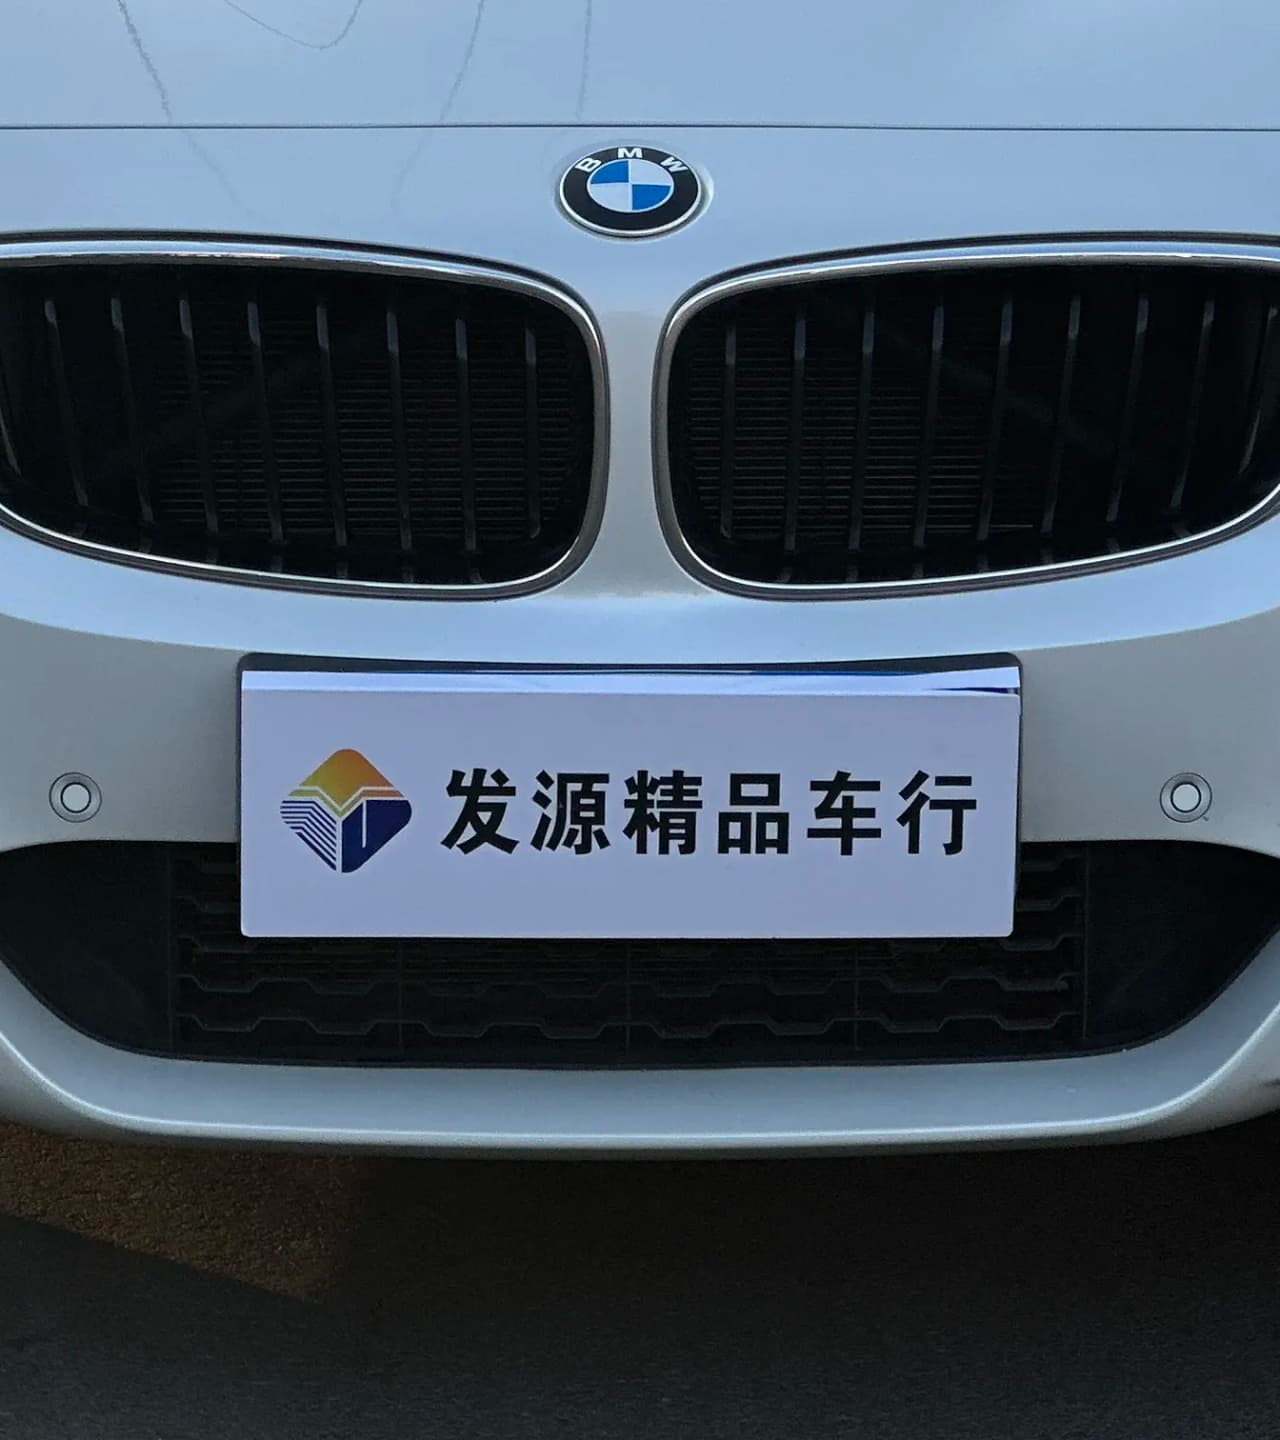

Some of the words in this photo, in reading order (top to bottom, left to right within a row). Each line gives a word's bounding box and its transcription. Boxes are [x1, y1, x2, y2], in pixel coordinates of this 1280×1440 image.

[574, 147, 689, 173] BMW
[441, 767, 979, 856] 发源精品车行
